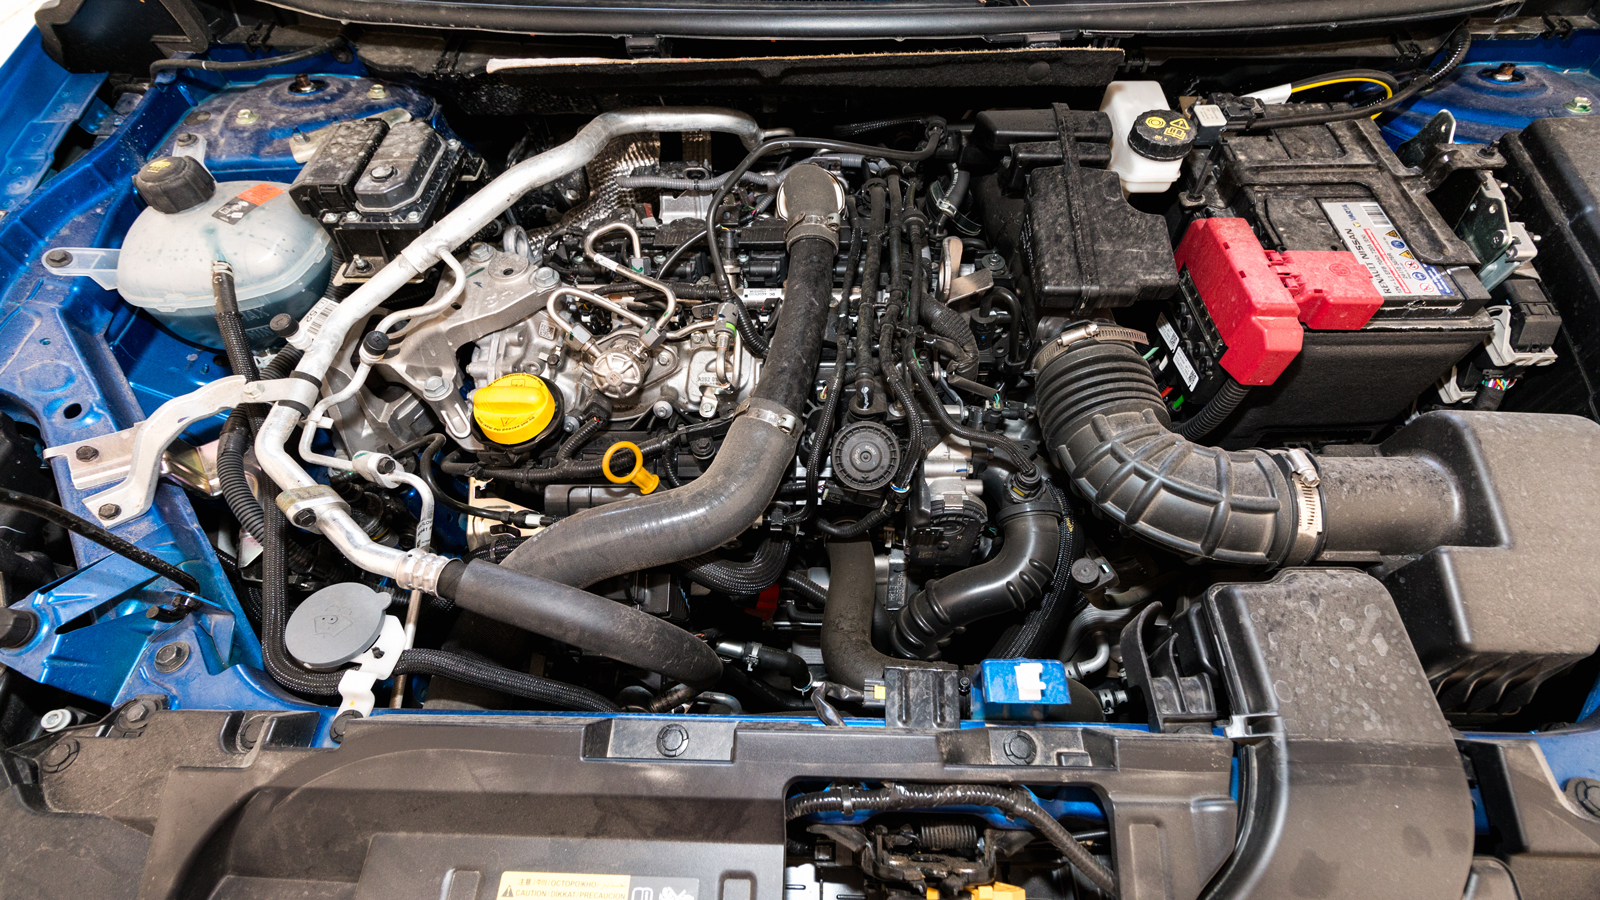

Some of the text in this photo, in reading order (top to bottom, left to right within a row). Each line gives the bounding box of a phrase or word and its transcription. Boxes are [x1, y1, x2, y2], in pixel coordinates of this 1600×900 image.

[1341, 204, 1356, 221] VARTA
[1345, 228, 1370, 260] NISSAN
[1365, 262, 1392, 293] RENAULT
[306, 310, 318, 323] 52
[246, 327, 275, 340] MIN
